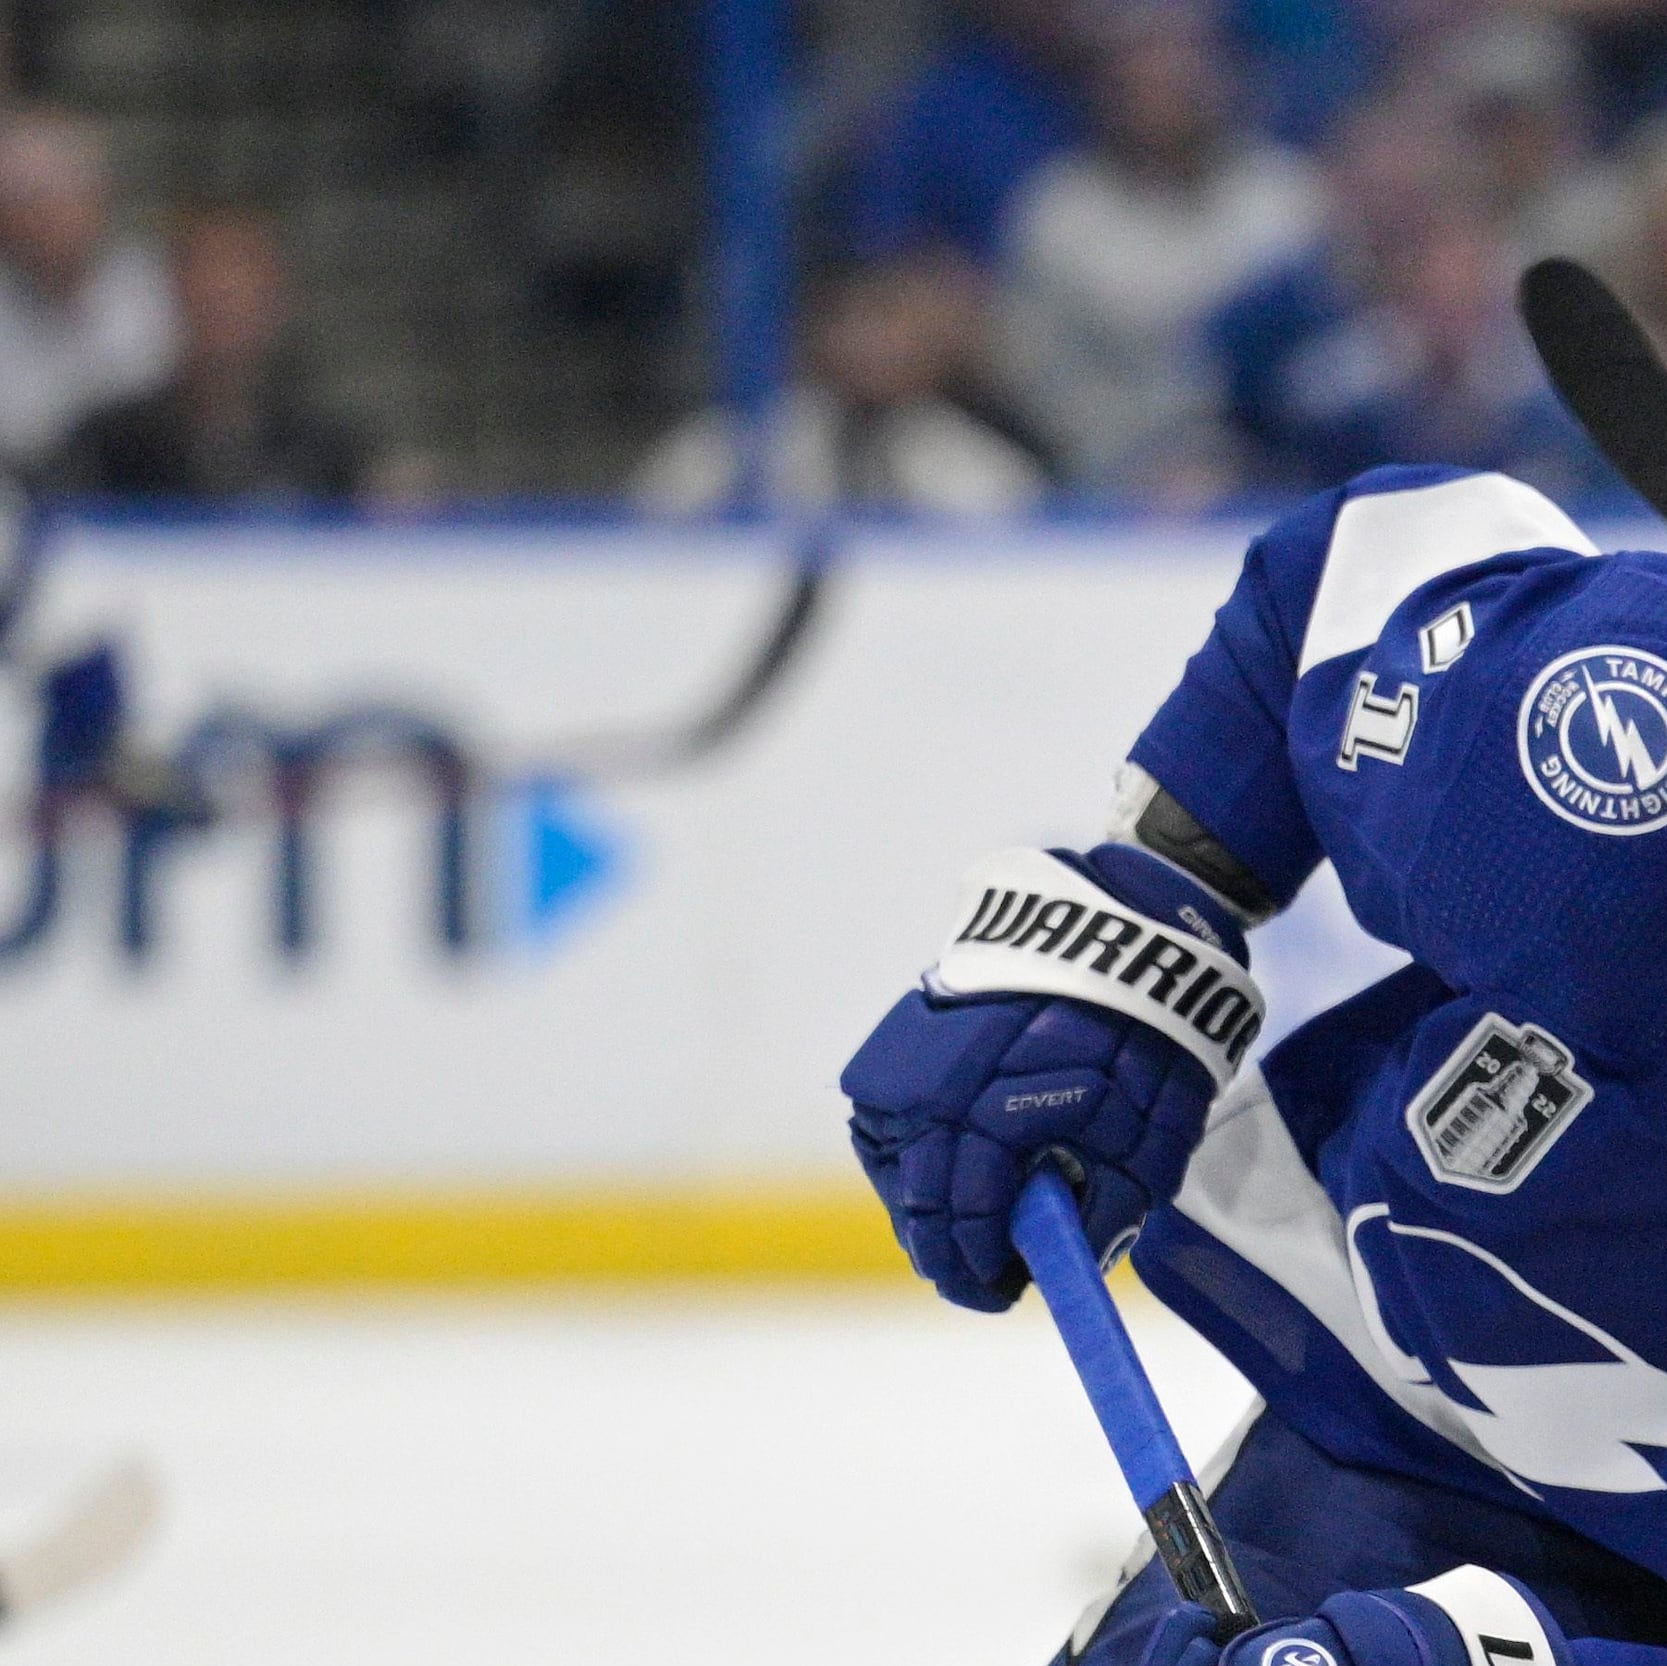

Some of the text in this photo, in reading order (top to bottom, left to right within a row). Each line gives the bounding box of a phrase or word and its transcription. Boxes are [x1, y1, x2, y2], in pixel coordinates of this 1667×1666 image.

[1004, 1087, 1088, 1113] COVERT
[1475, 1051, 1557, 1119] 20 22
